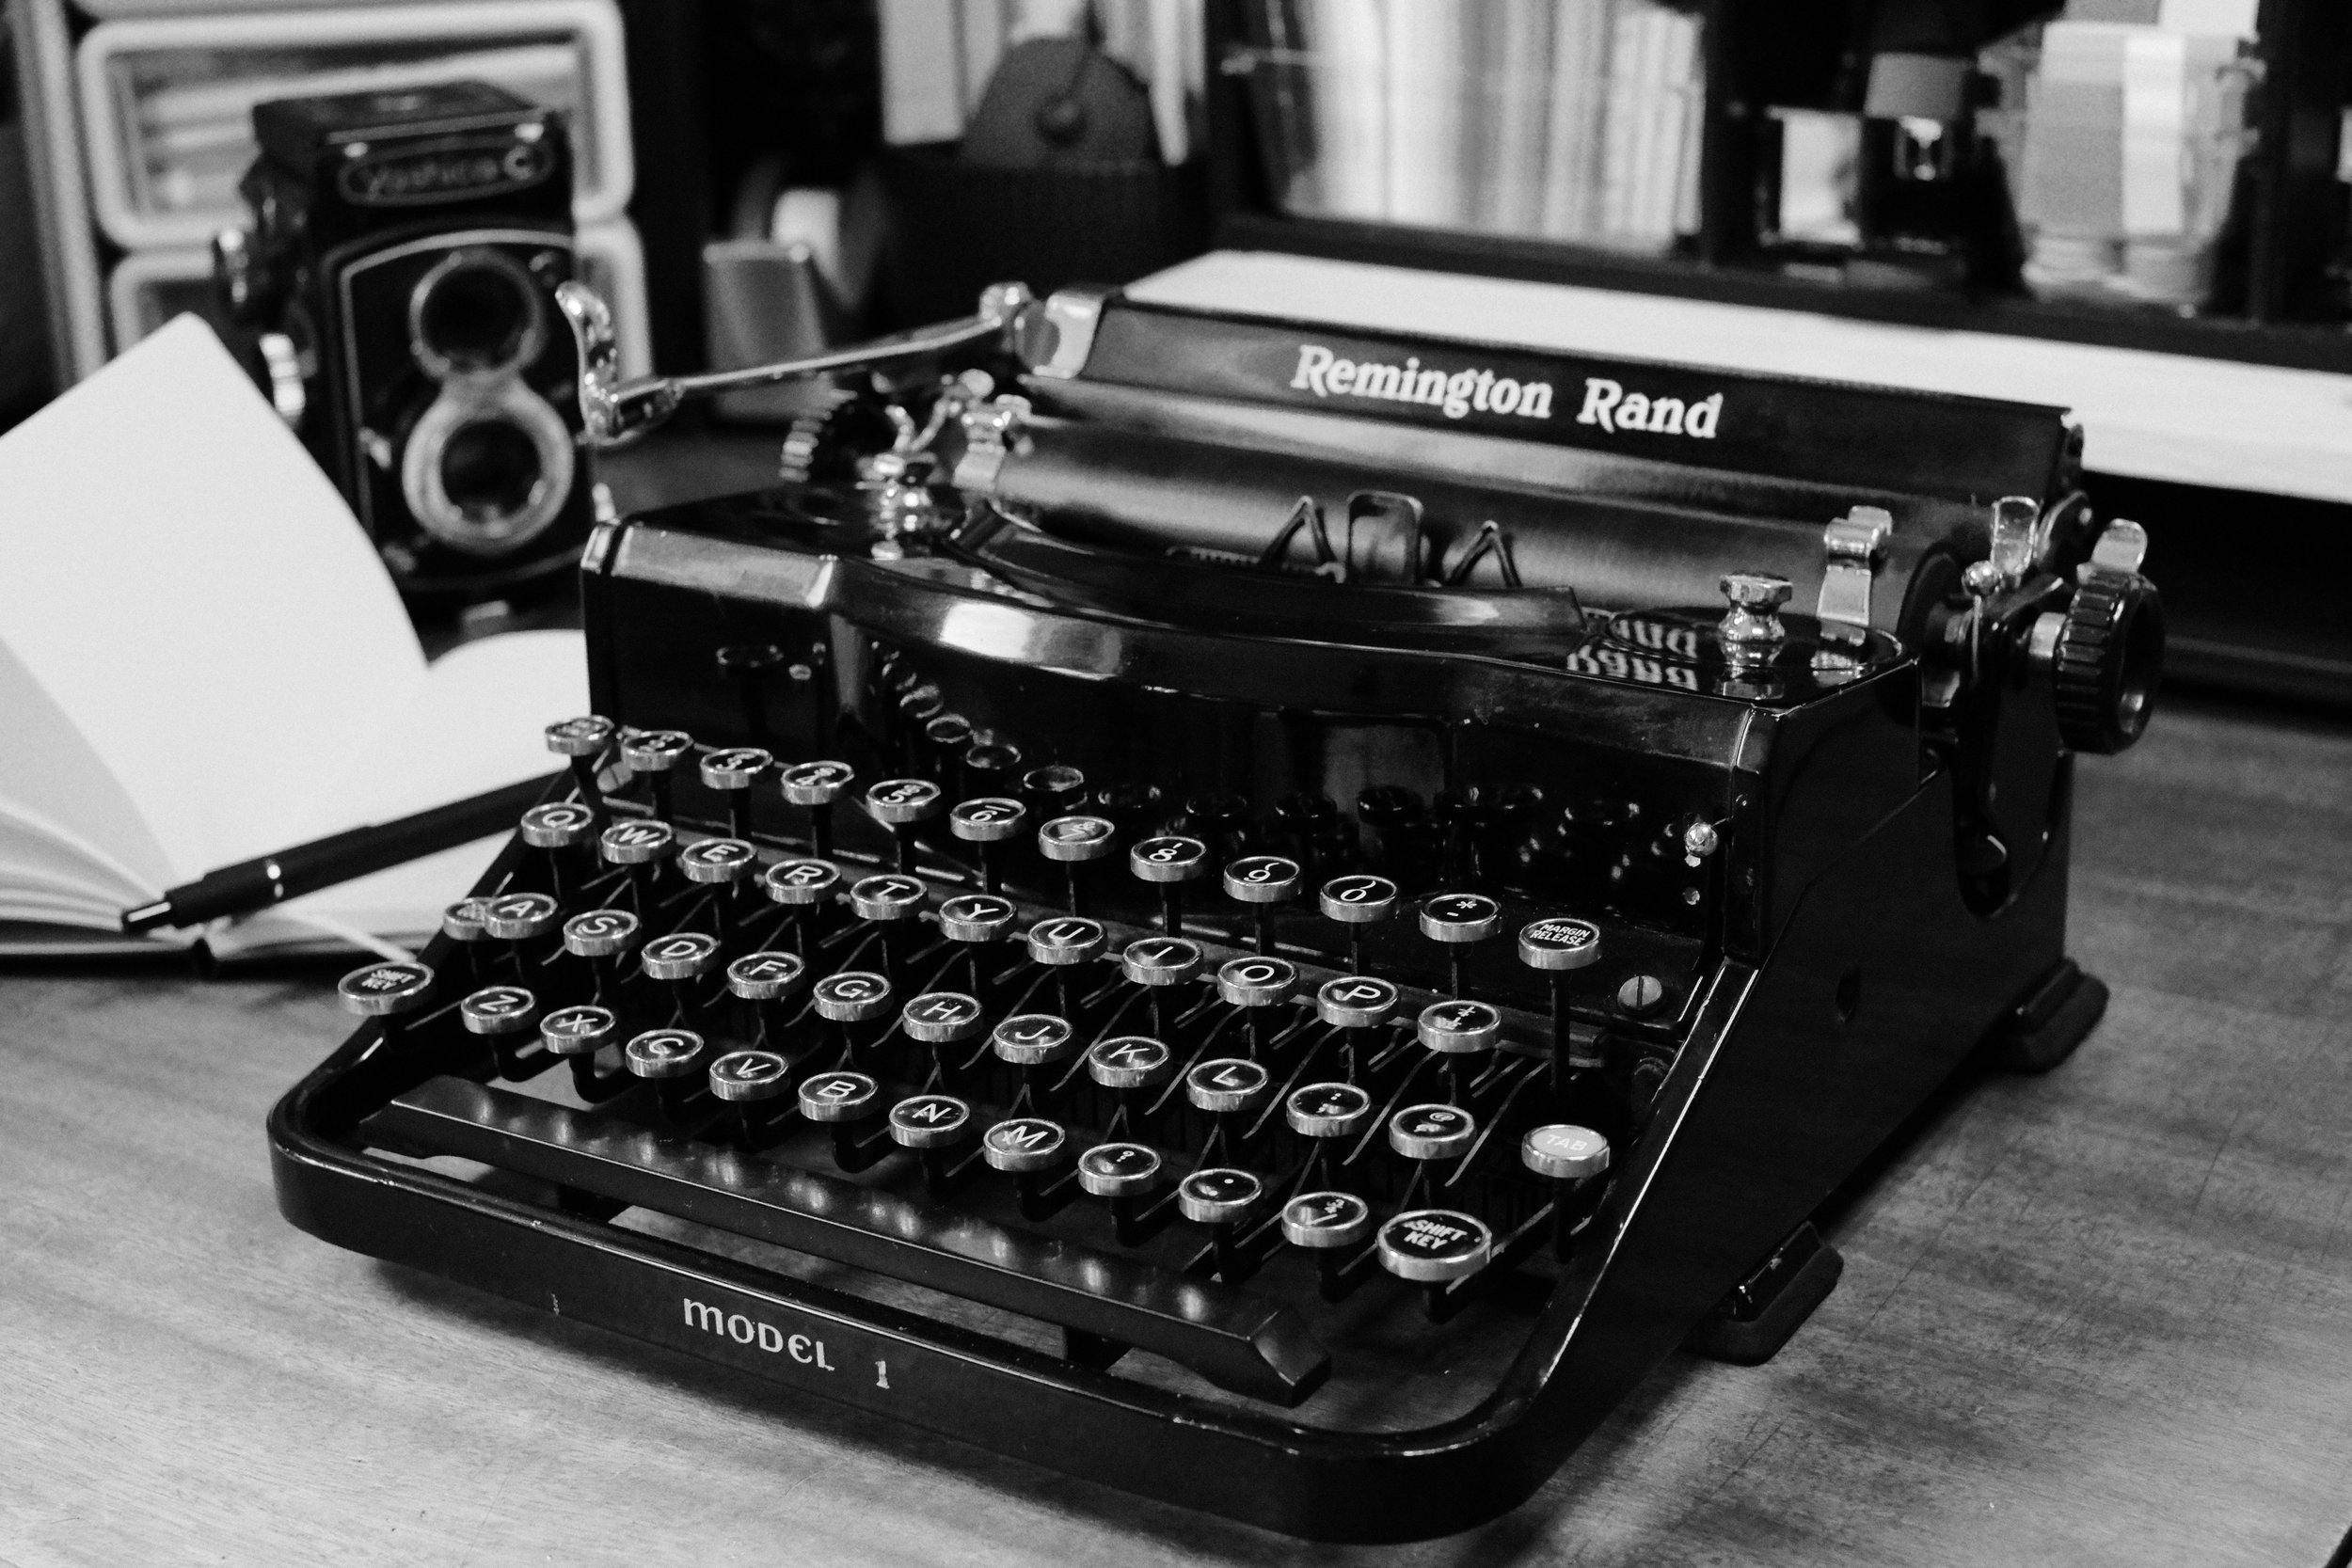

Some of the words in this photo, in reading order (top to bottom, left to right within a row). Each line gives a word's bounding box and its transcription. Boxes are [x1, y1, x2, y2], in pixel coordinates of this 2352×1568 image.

[1291, 344, 1552, 420] Remington
[1577, 377, 1724, 439] Rand
[542, 809, 575, 828] Q
[619, 826, 659, 844] W
[706, 845, 739, 861] E
[787, 866, 823, 883] R
[877, 881, 911, 898] T
[498, 900, 535, 916] A
[967, 903, 1000, 920] Y
[581, 917, 618, 934] S
[1046, 923, 1087, 939] U
[1541, 924, 1591, 938] MARGIN
[1530, 929, 1585, 946] RELEASE
[660, 941, 697, 957] D
[1152, 946, 1174, 959] I
[748, 959, 787, 974] F
[1240, 965, 1275, 981] O
[834, 980, 871, 998] G
[1343, 986, 1381, 1003] P
[479, 994, 518, 1011] Z
[921, 1002, 962, 1020] H
[558, 1013, 597, 1031] X
[1014, 1025, 1051, 1040] J
[648, 1037, 684, 1055] C
[1108, 1044, 1150, 1063] K
[737, 1059, 771, 1078] V
[1212, 1067, 1238, 1085] L
[817, 1081, 857, 1098] B
[917, 1103, 953, 1123] N
[1008, 1125, 1048, 1146] M
[1546, 1134, 1588, 1151] TAB
[1412, 1219, 1468, 1242] SHIFT
[1403, 1231, 1448, 1250] KEY
[683, 1298, 835, 1371] MODEL
[875, 1360, 890, 1389] 1
